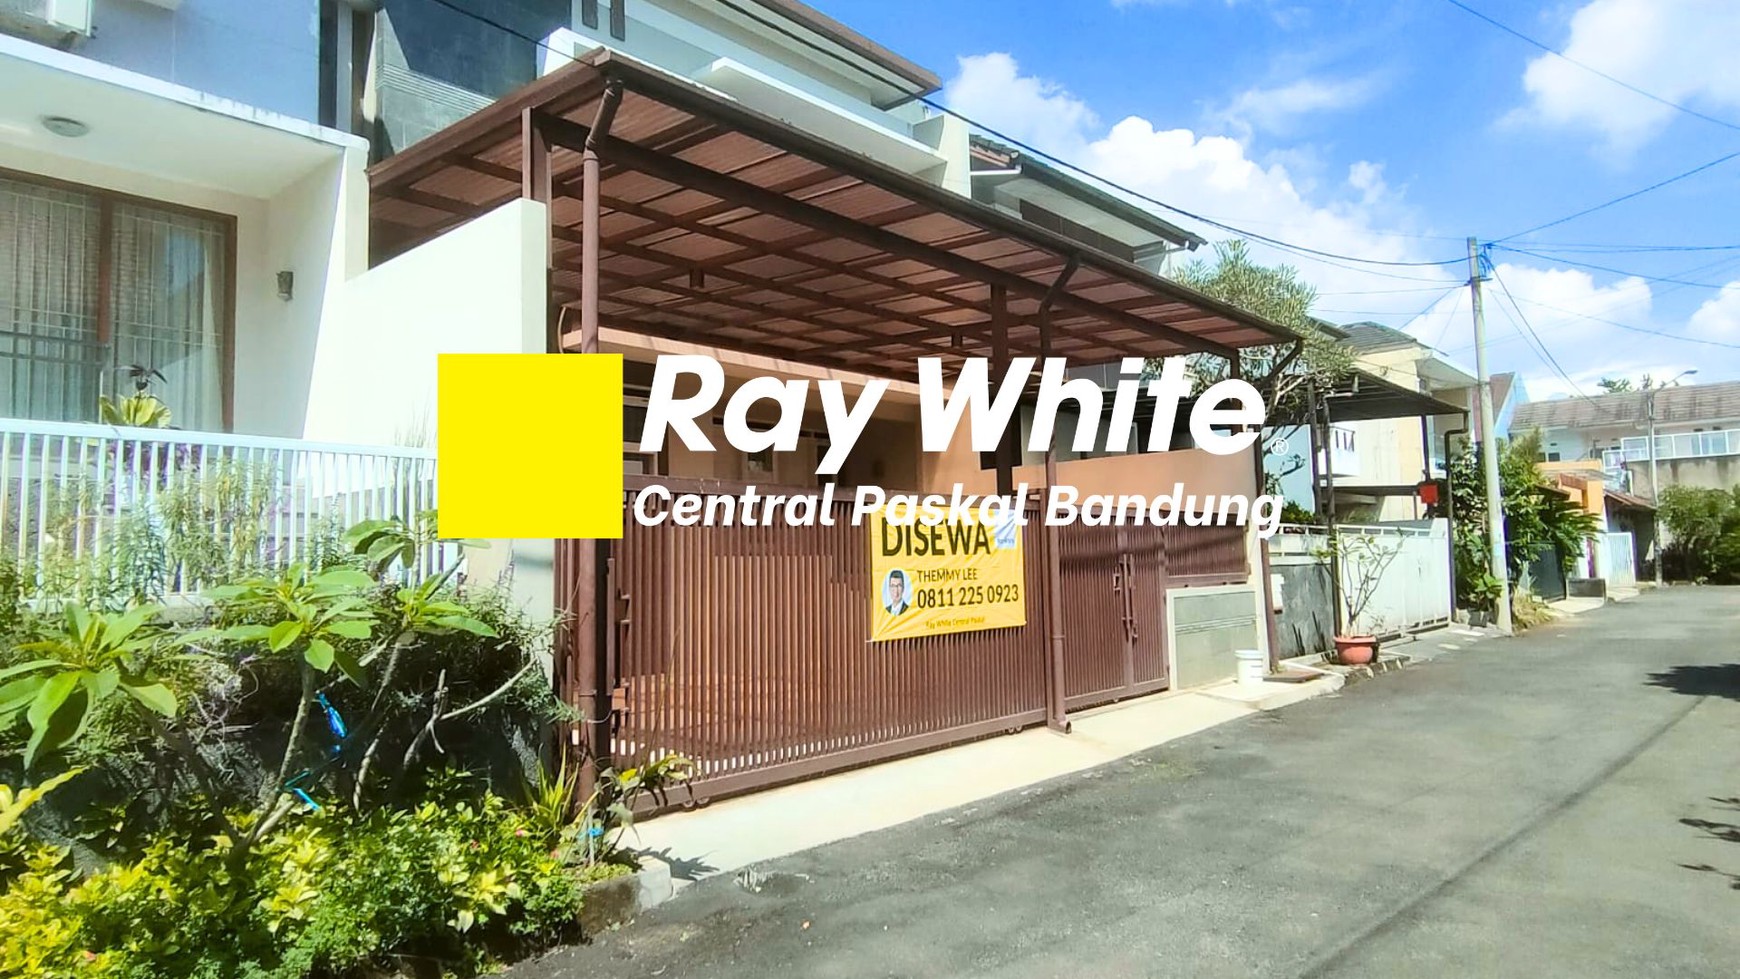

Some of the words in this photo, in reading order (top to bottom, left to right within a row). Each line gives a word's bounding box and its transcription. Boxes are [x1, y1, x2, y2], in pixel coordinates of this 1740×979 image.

[881, 516, 991, 557] DISEWA
[917, 569, 961, 583] THEMMY
[962, 568, 979, 581] LEE
[917, 588, 955, 609] 0811
[958, 585, 985, 607] 225
[986, 583, 1019, 604] 0923
